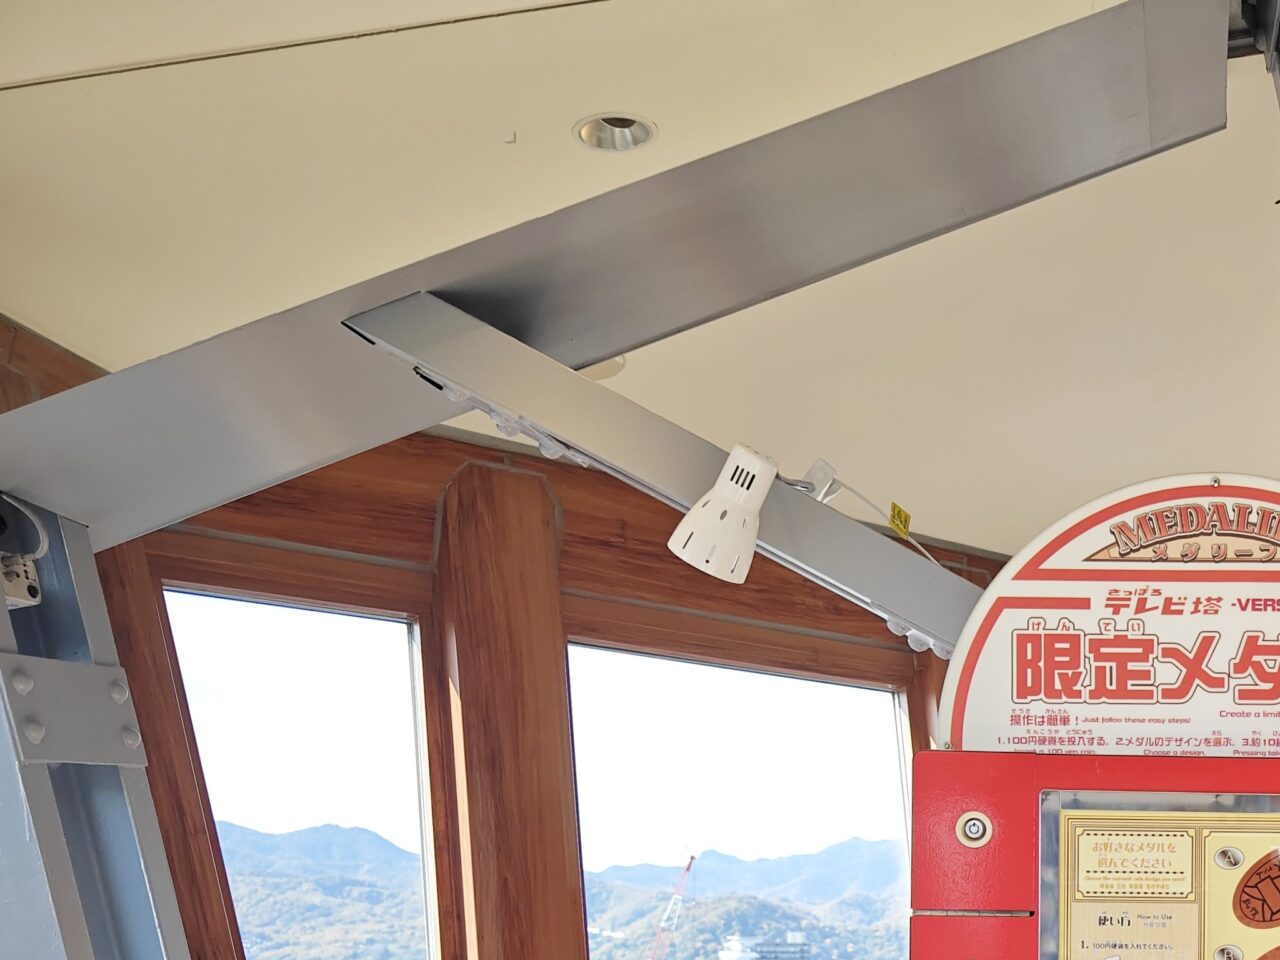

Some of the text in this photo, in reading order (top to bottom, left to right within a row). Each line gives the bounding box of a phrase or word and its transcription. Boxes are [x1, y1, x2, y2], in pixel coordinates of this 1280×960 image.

[1151, 543, 1278, 562] メダリーフ
[1107, 585, 1163, 596] さっぽろ
[1105, 597, 1223, 615] テレビ塔
[1219, 710, 1251, 718] Create
[1092, 842, 1177, 853] お好きなメダルを
[1225, 851, 1235, 865] A
